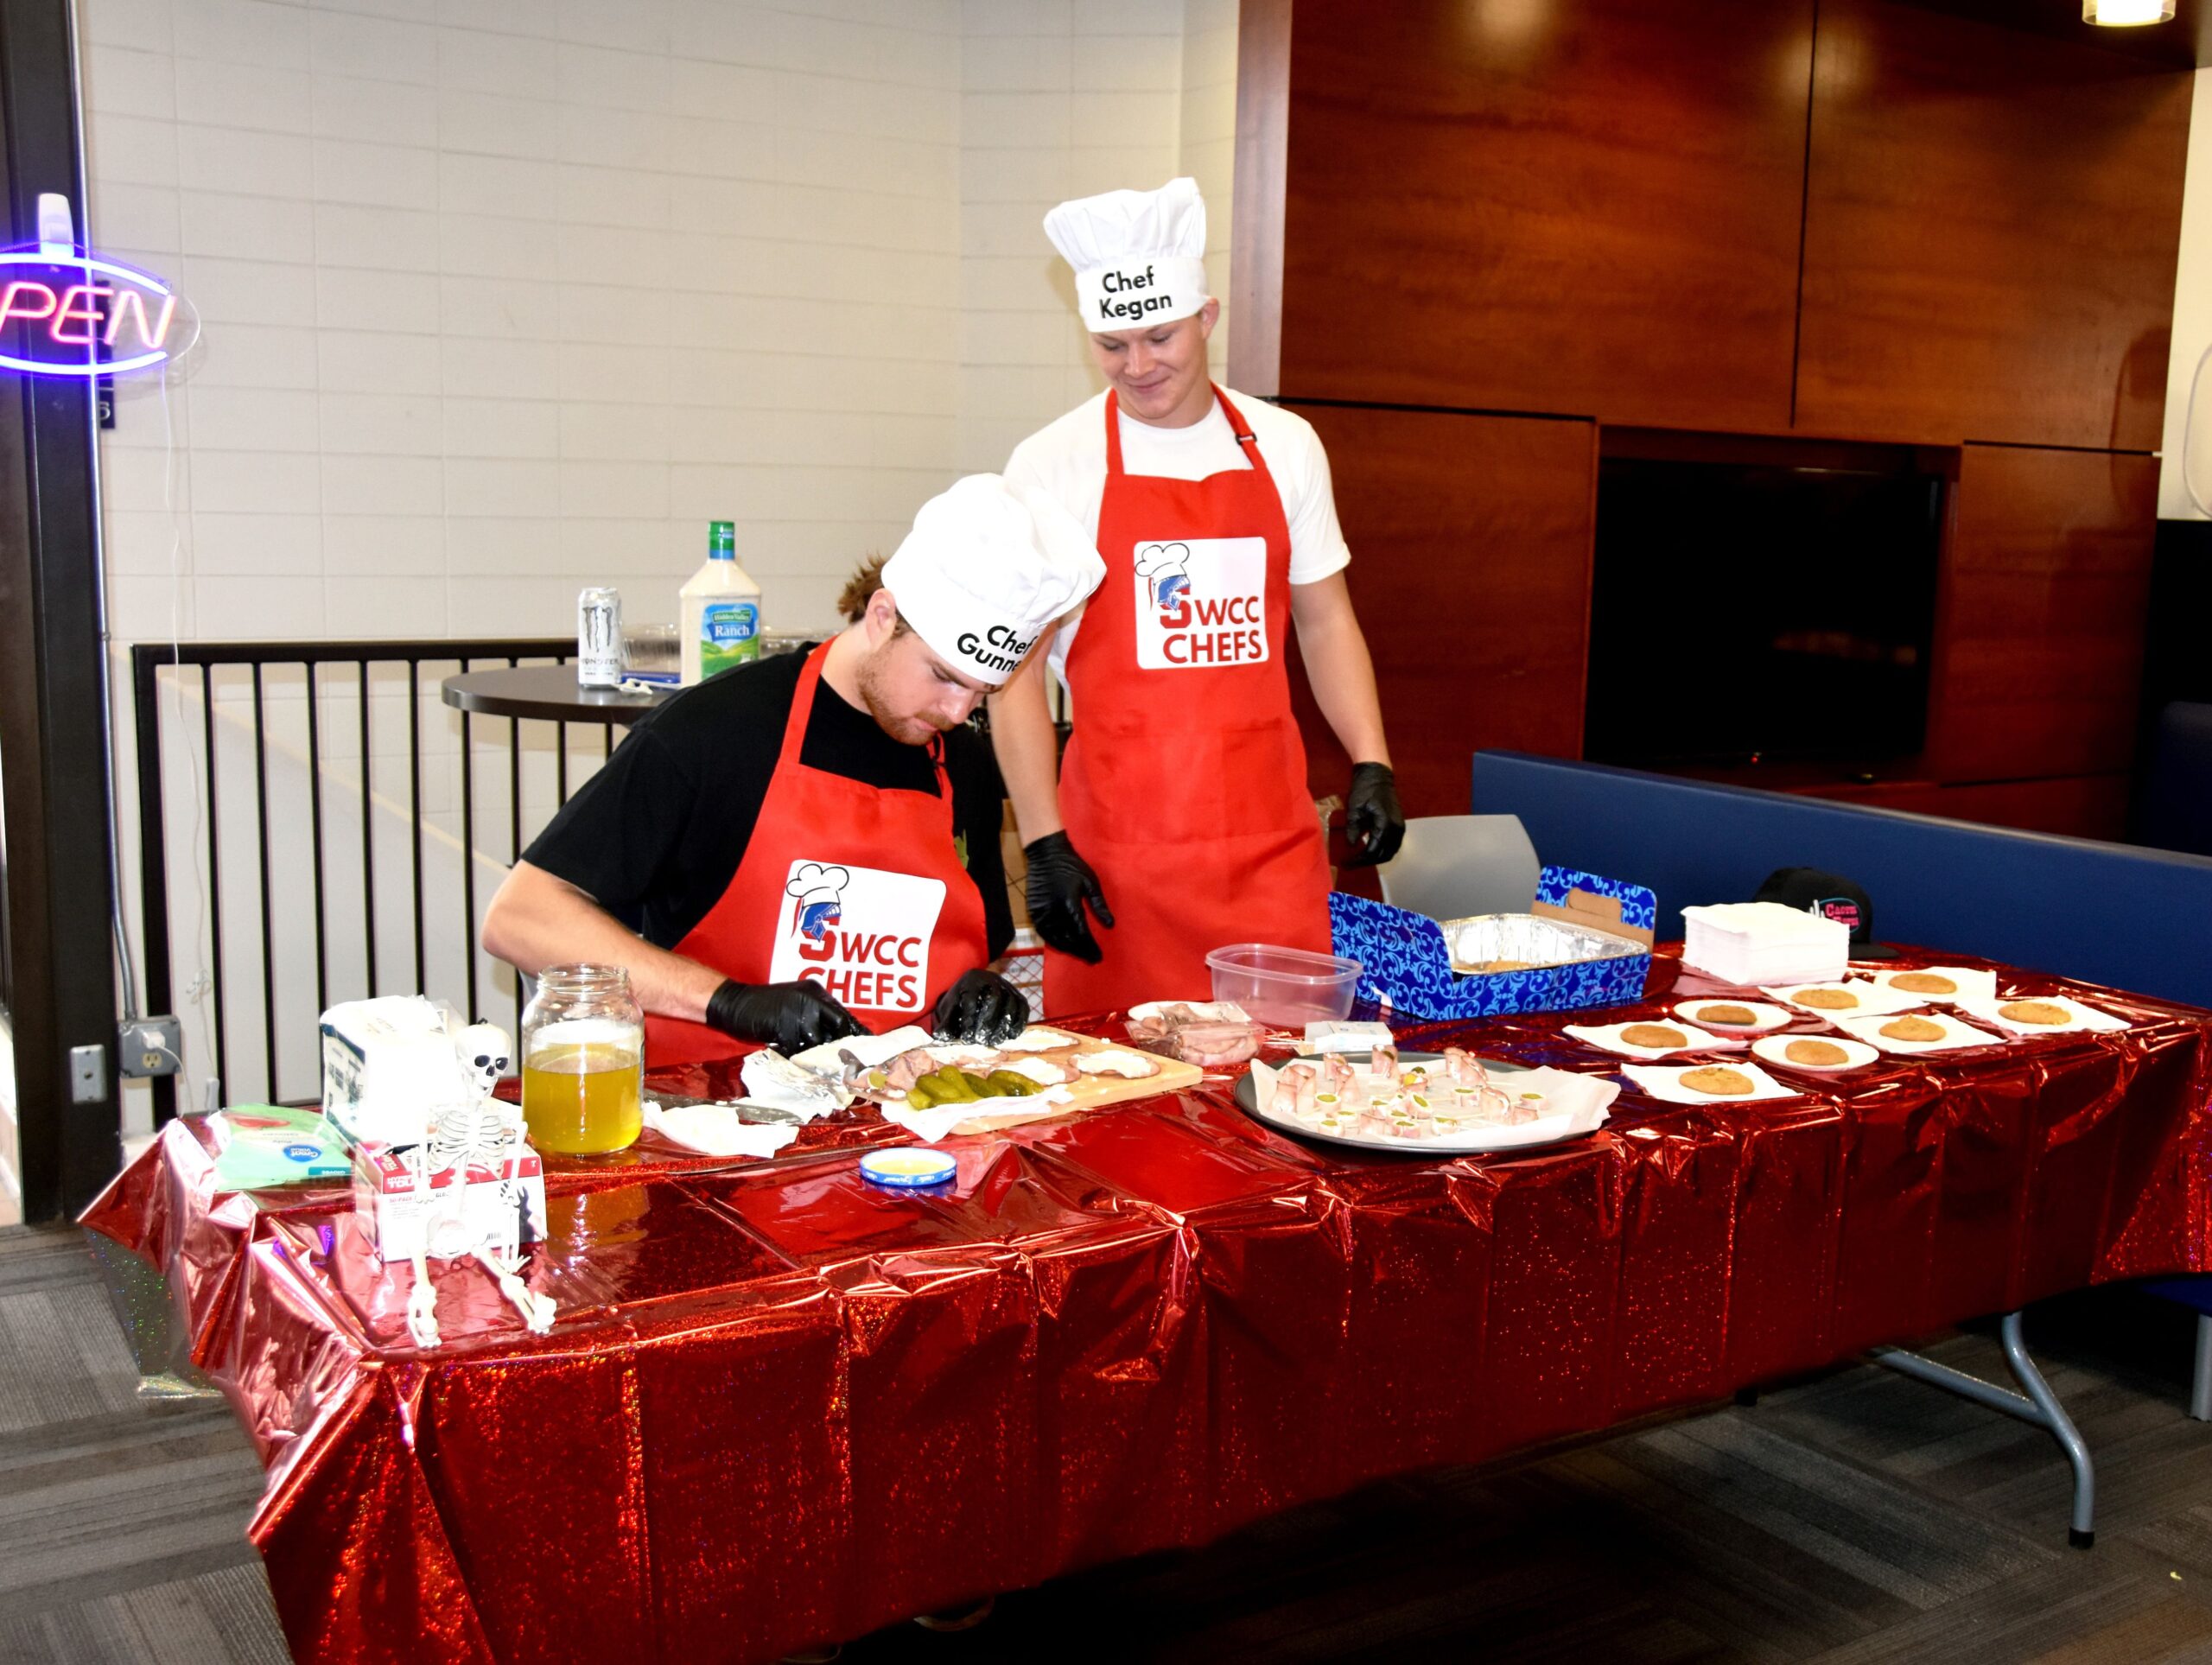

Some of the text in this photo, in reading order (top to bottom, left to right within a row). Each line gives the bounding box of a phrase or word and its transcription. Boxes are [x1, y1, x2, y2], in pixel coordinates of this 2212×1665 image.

[1102, 265, 1154, 293] Chef
[1099, 295, 1173, 321] Kegan
[1160, 586, 1260, 629] SWCC
[715, 624, 750, 637] Ranch
[1163, 630, 1262, 664] CHEFS
[798, 916, 922, 968] SWCC
